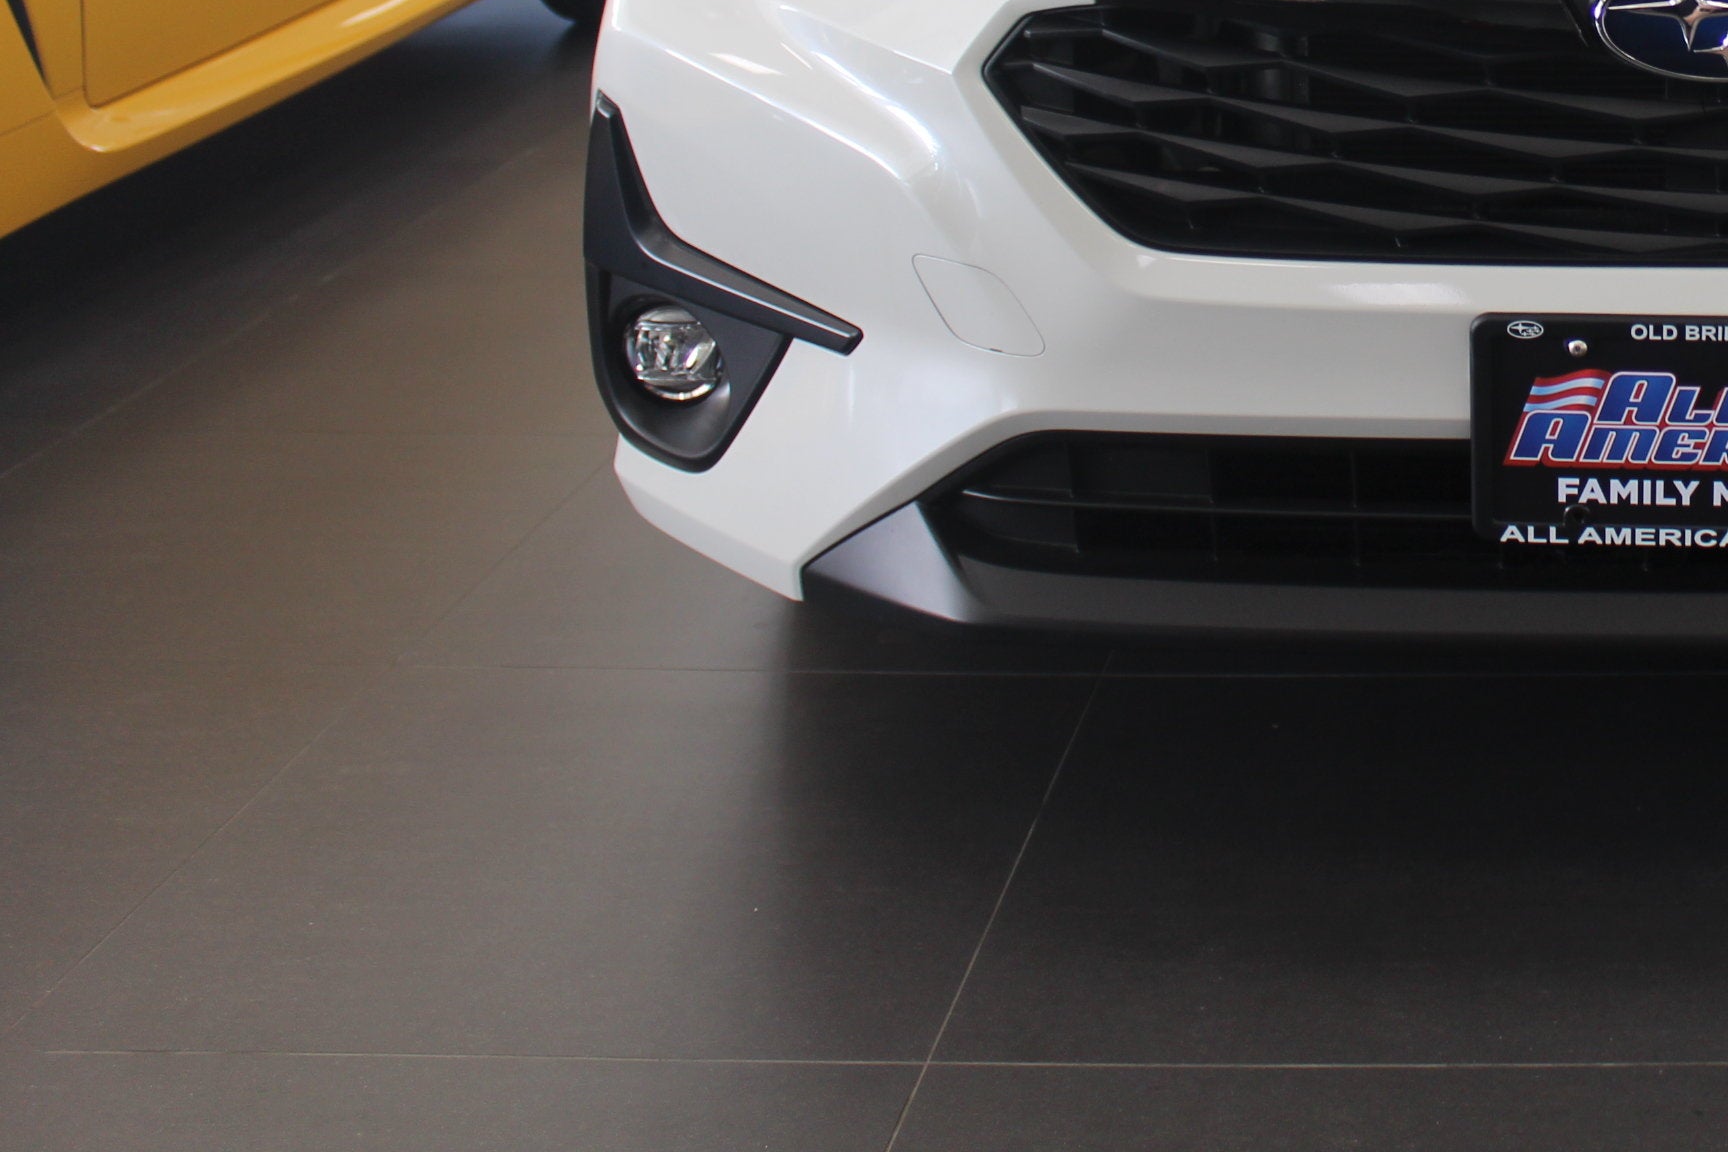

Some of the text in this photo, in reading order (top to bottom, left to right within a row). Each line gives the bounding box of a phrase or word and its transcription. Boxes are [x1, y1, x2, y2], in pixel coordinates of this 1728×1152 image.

[1631, 324, 1678, 340] OLD
[1557, 477, 1699, 505] FAMILY
[1500, 525, 1569, 544] ALL
